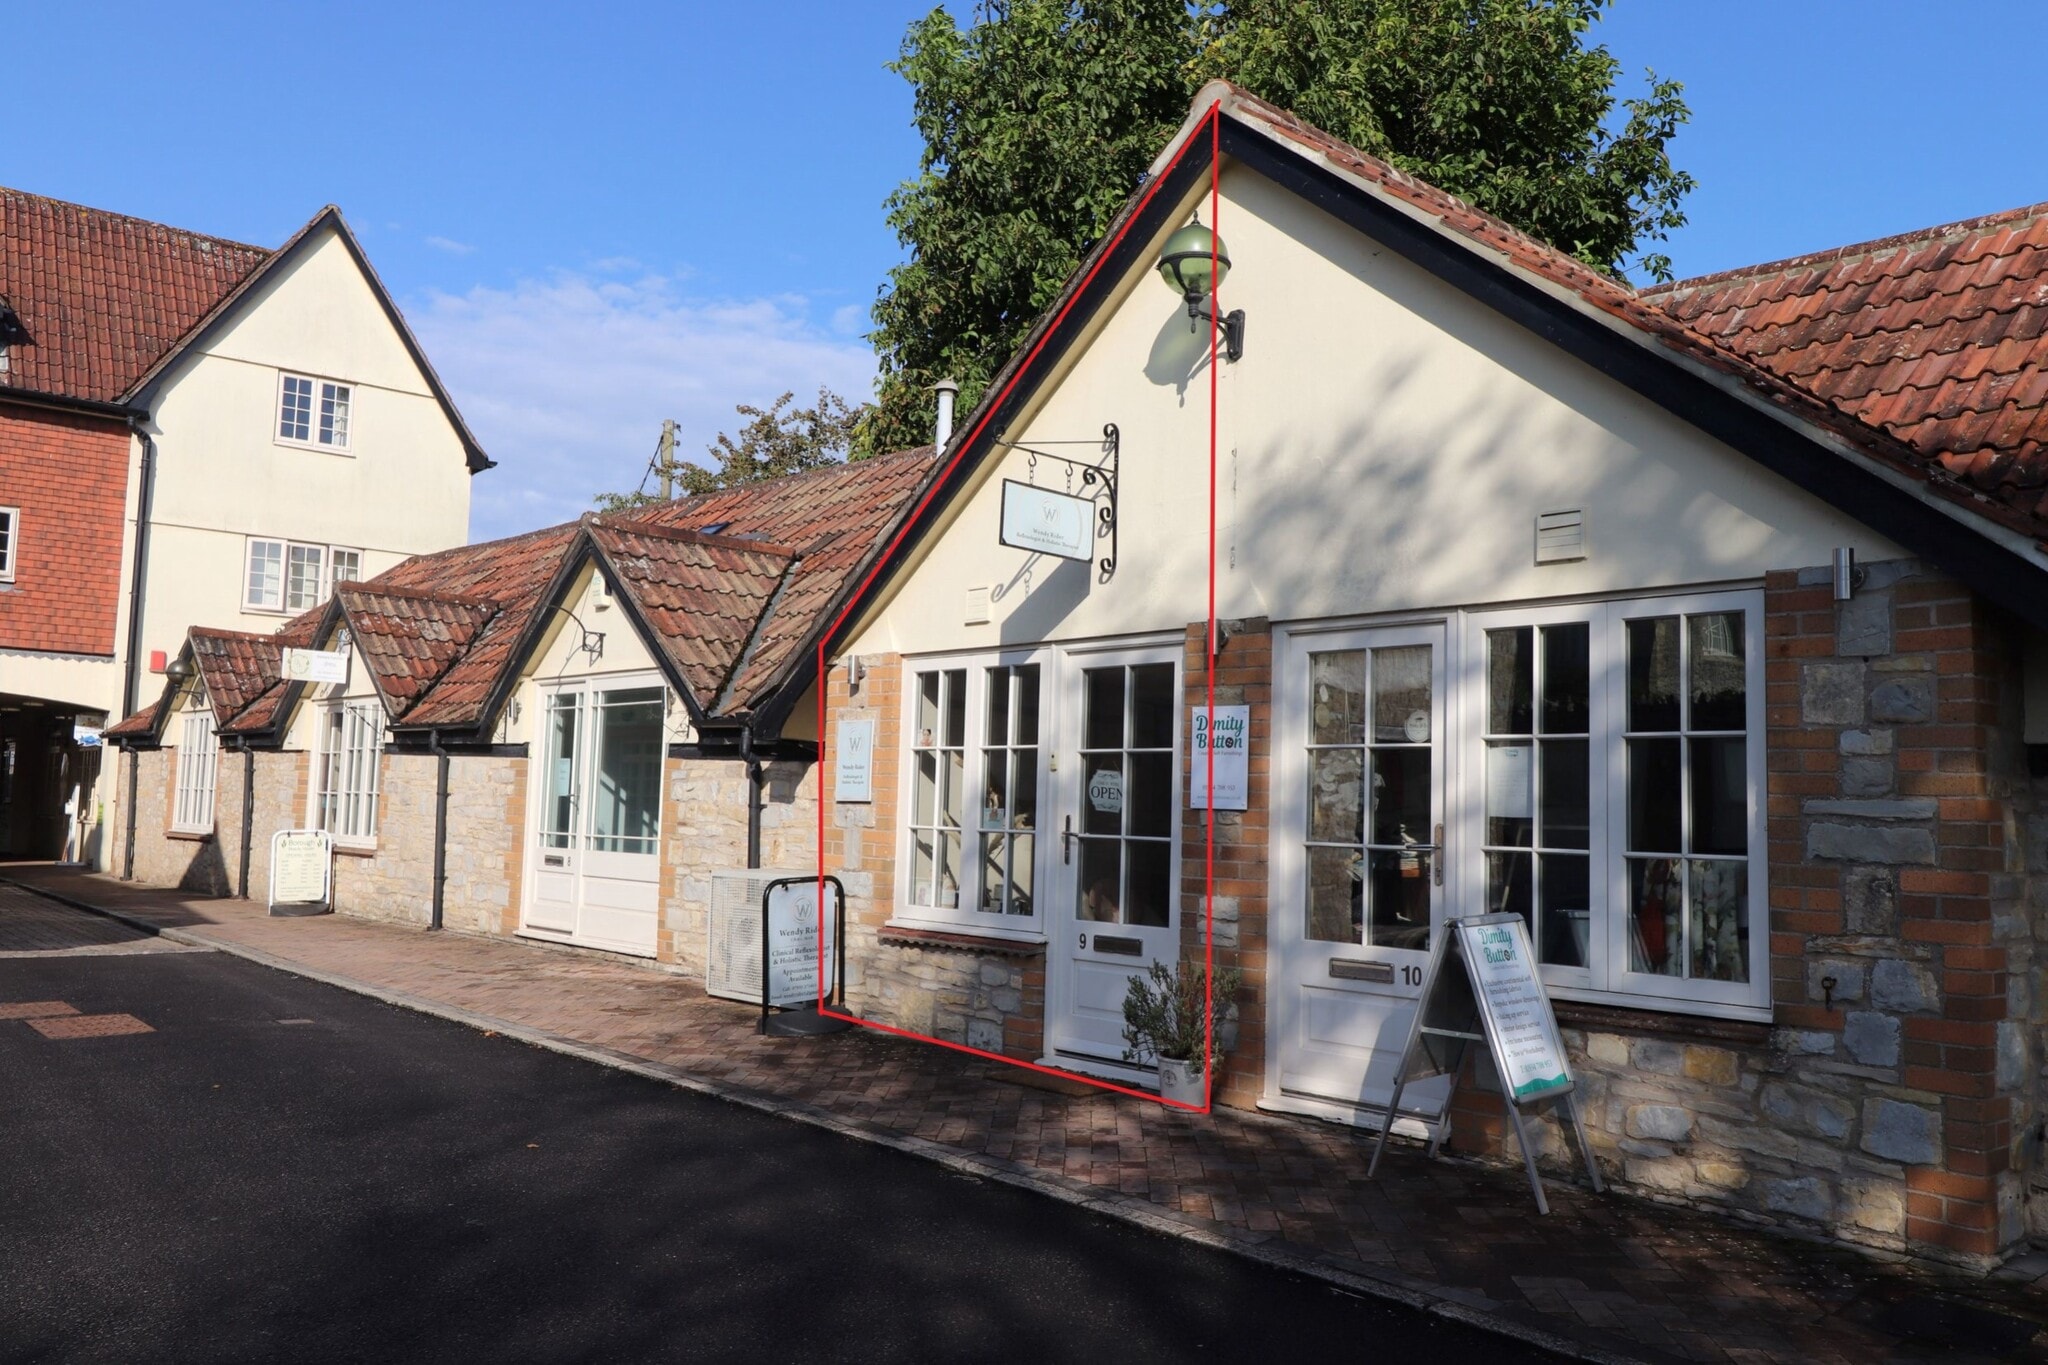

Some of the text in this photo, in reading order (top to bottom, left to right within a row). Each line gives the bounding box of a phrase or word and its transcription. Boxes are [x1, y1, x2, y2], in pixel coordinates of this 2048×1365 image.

[1196, 715, 1244, 737] Dmity
[796, 905, 809, 918] W
[780, 926, 825, 936] Wendy Rid
[1478, 927, 1512, 949] Dimity
[1079, 933, 1087, 949] 9
[1484, 947, 1517, 963] Button
[1401, 965, 1422, 986] 10
